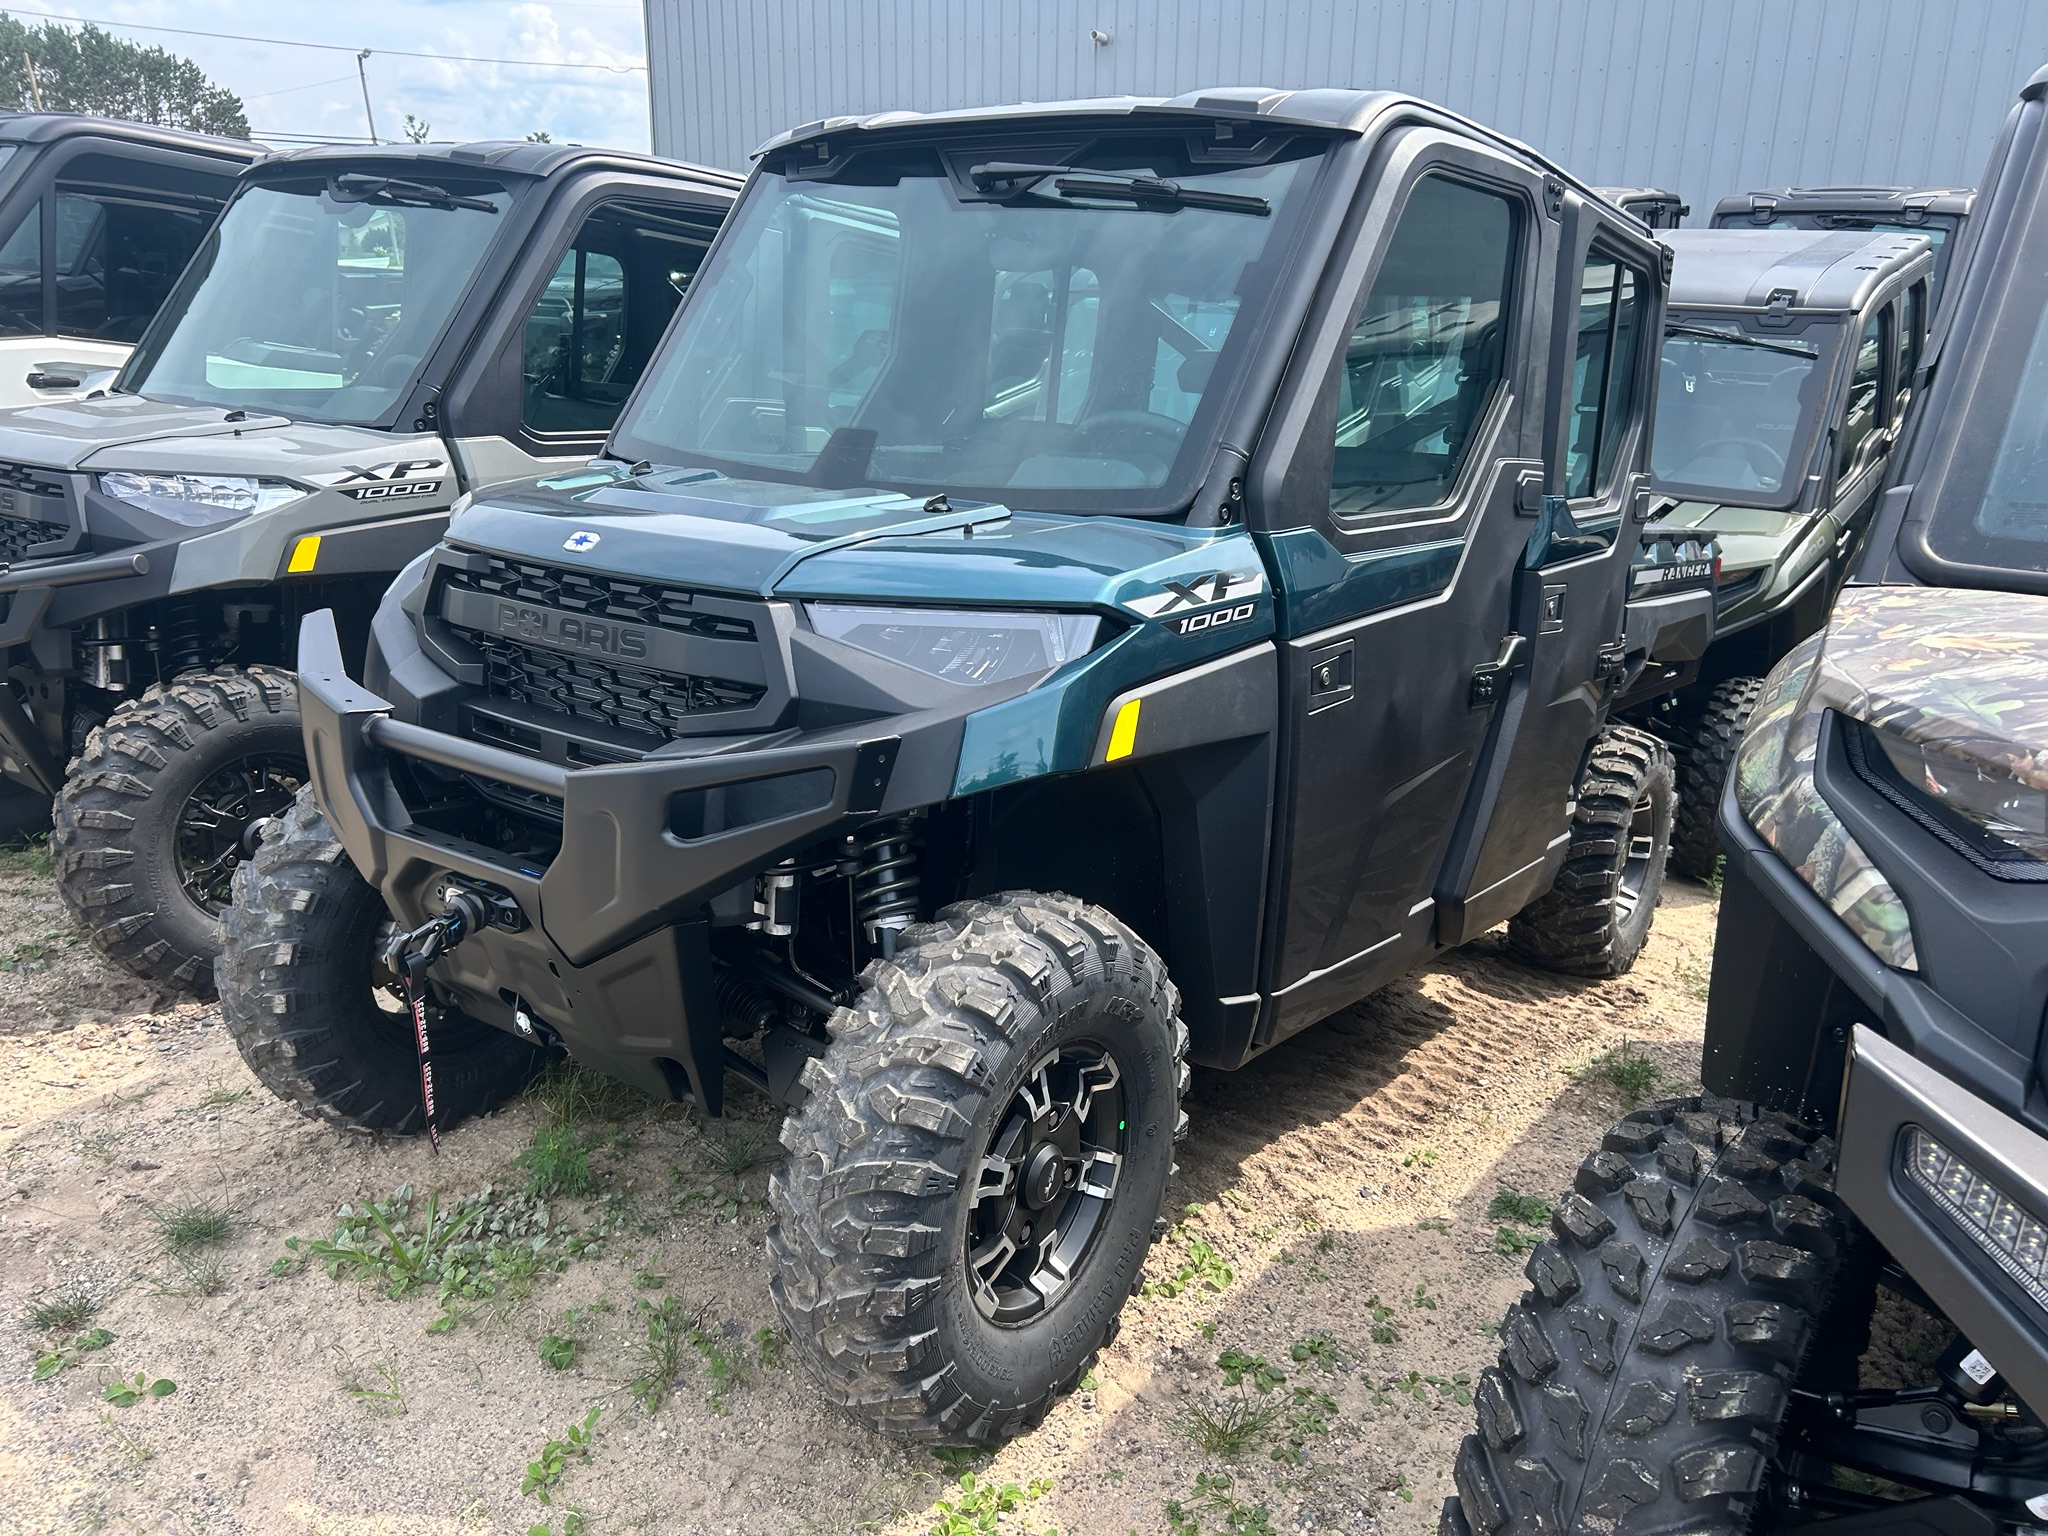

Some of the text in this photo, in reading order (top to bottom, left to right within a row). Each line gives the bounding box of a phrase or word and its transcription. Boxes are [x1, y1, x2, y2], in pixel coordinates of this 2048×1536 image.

[1755, 422, 1796, 432] POLAR
[328, 459, 444, 485] XP
[356, 482, 436, 499] 1000
[1153, 566, 1259, 616] XP
[498, 603, 647, 660] POLARIS
[1179, 603, 1255, 634] 1000
